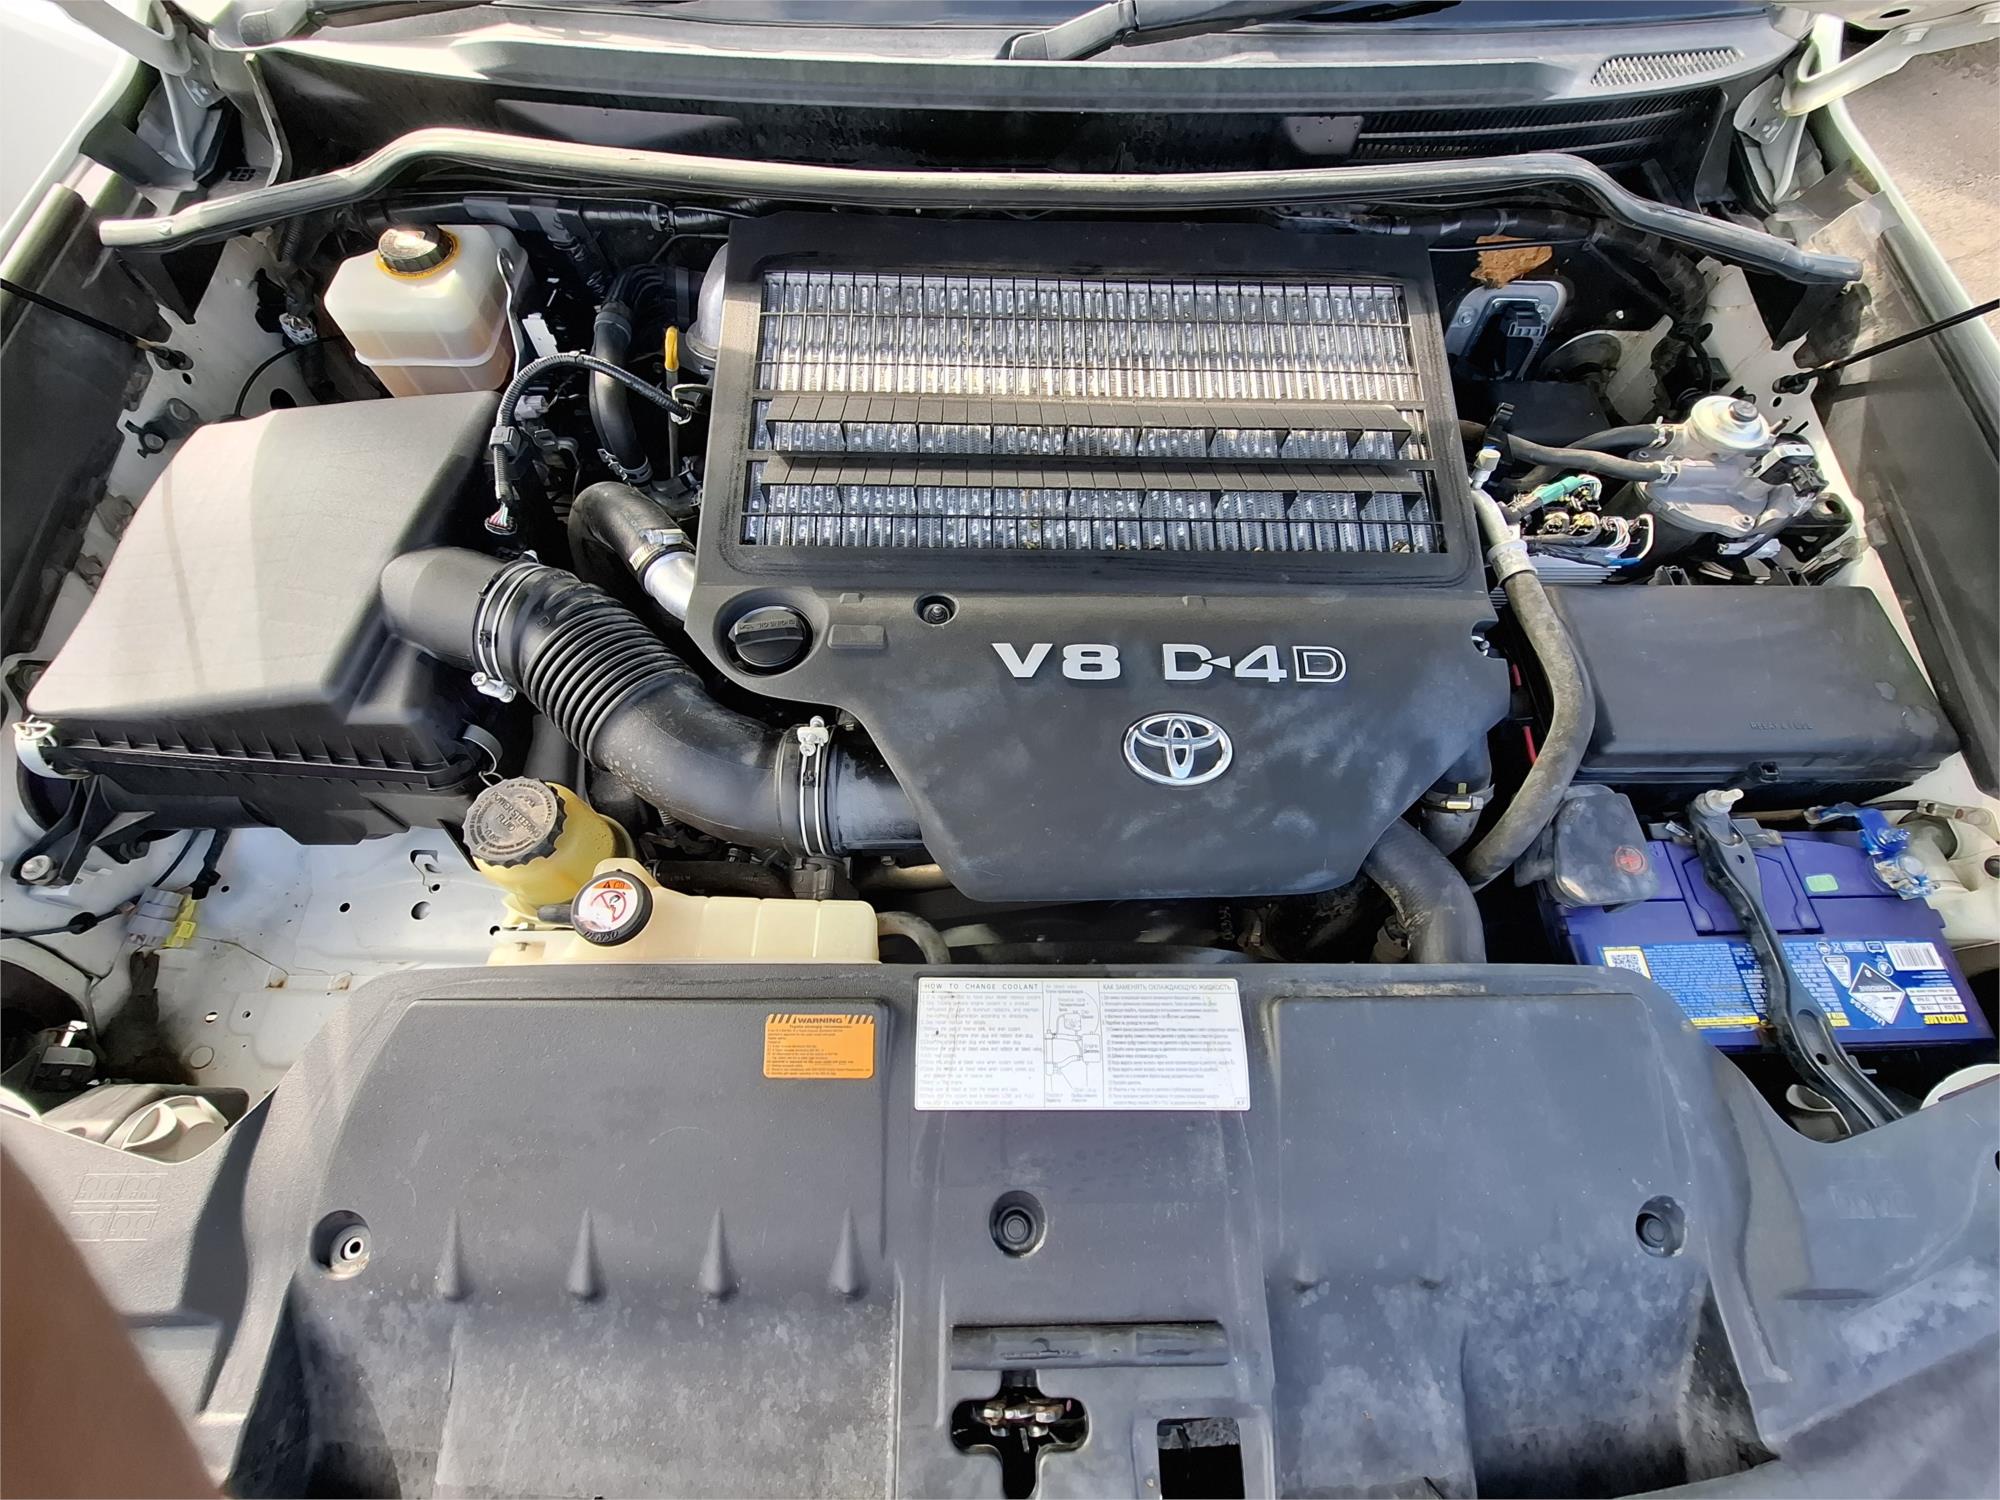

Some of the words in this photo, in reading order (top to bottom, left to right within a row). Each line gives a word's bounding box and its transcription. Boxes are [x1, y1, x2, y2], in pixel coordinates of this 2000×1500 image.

[991, 643, 1121, 680] V8
[490, 791, 514, 813] POWER
[511, 809, 543, 838] STEERING
[495, 813, 517, 832] FLUID
